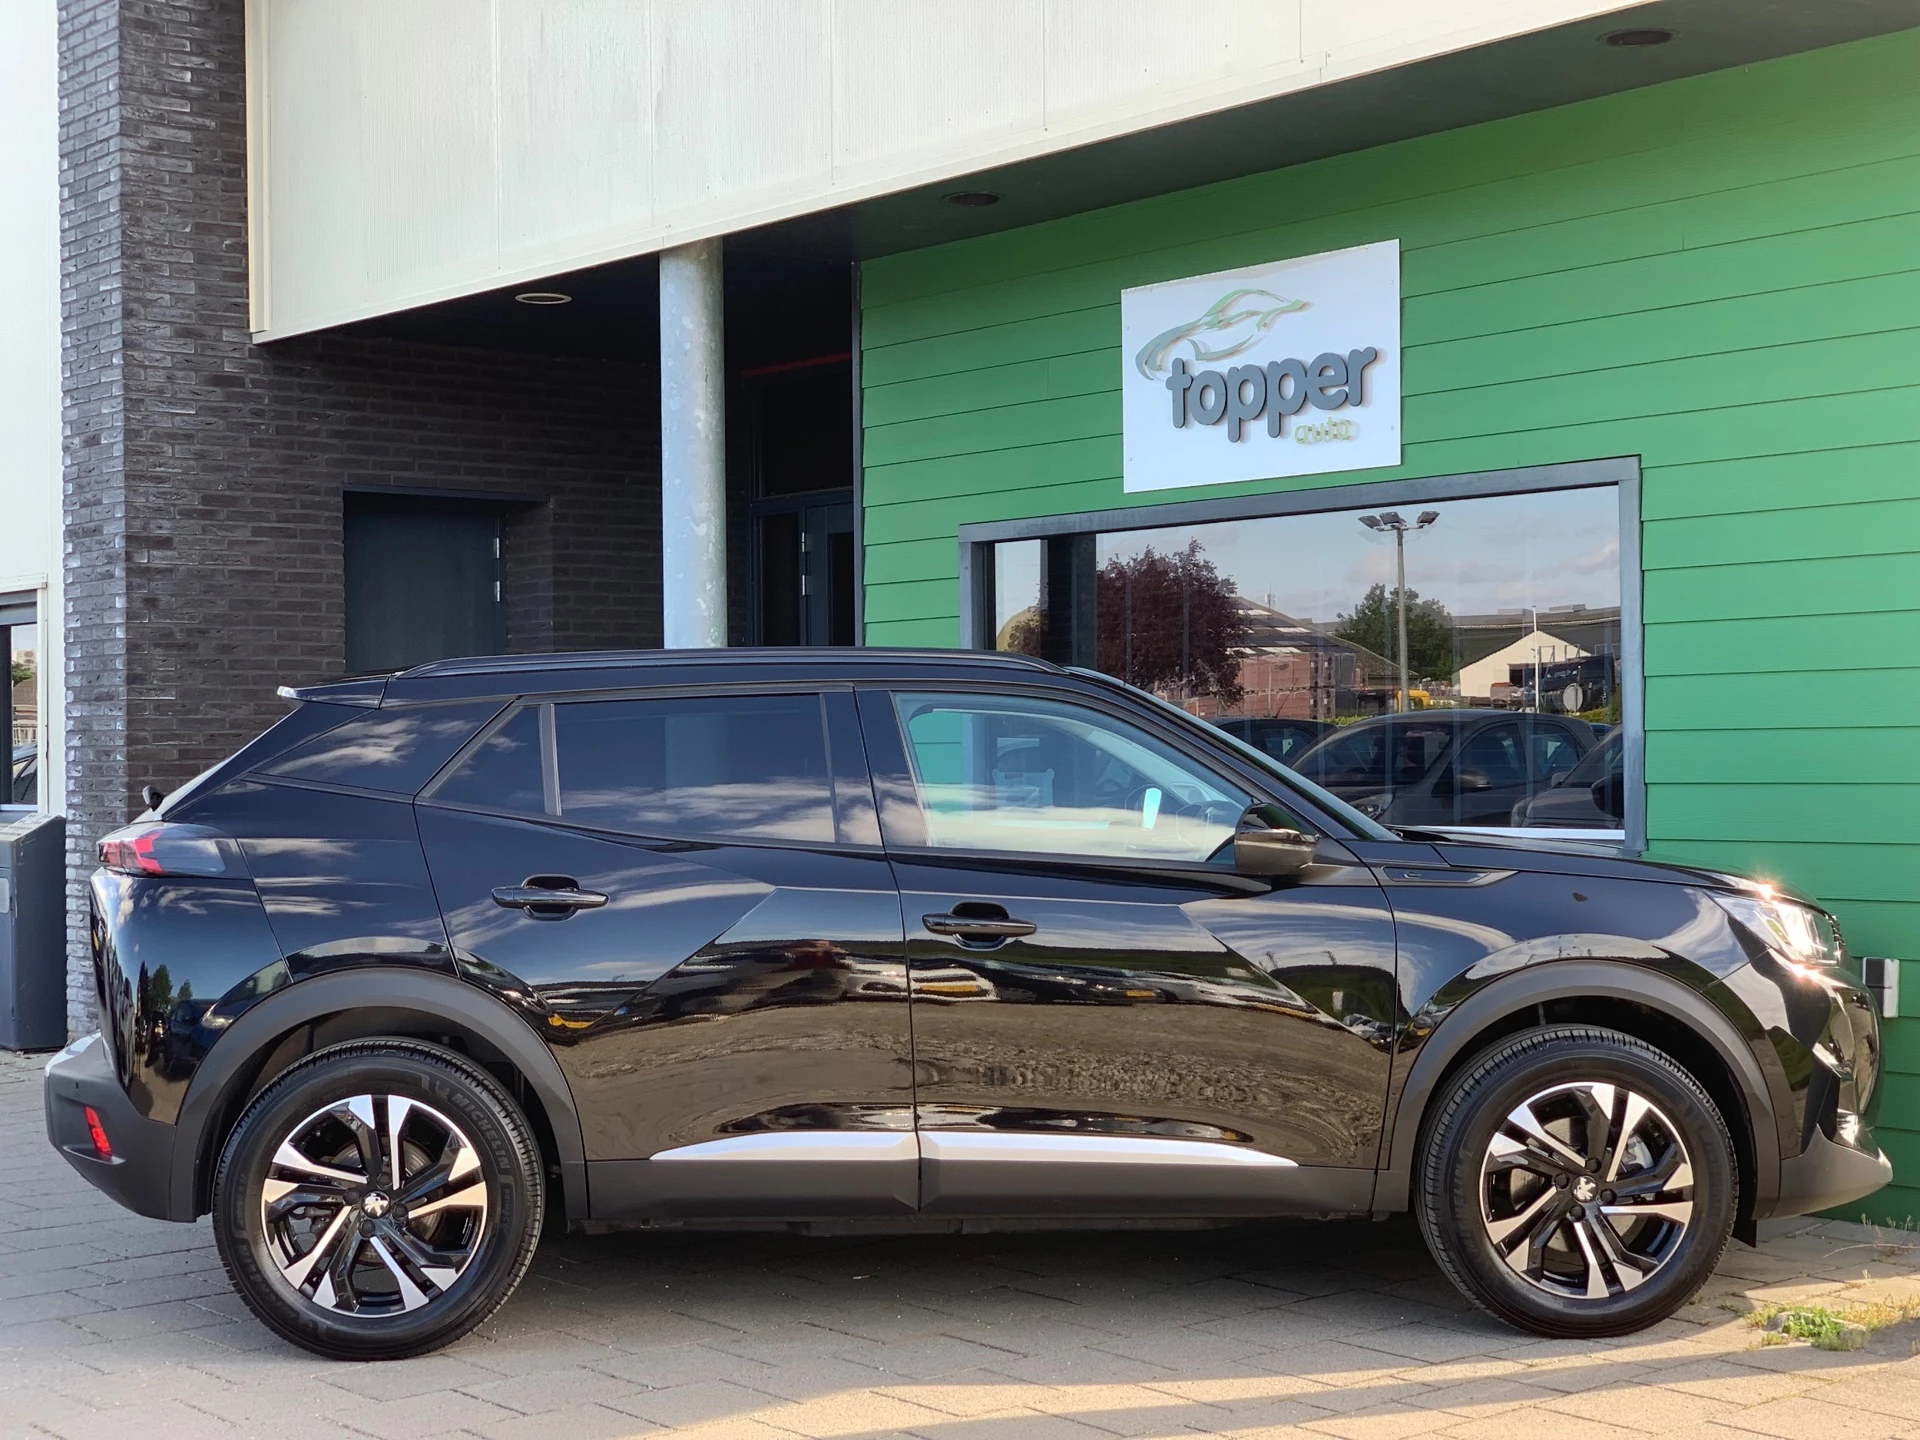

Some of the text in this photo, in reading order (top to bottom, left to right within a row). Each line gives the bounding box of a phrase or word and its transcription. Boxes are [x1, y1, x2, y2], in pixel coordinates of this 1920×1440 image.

[1165, 346, 1378, 443] topper
[1295, 417, 1350, 444] auto
[452, 1093, 511, 1169] MICHELIN
